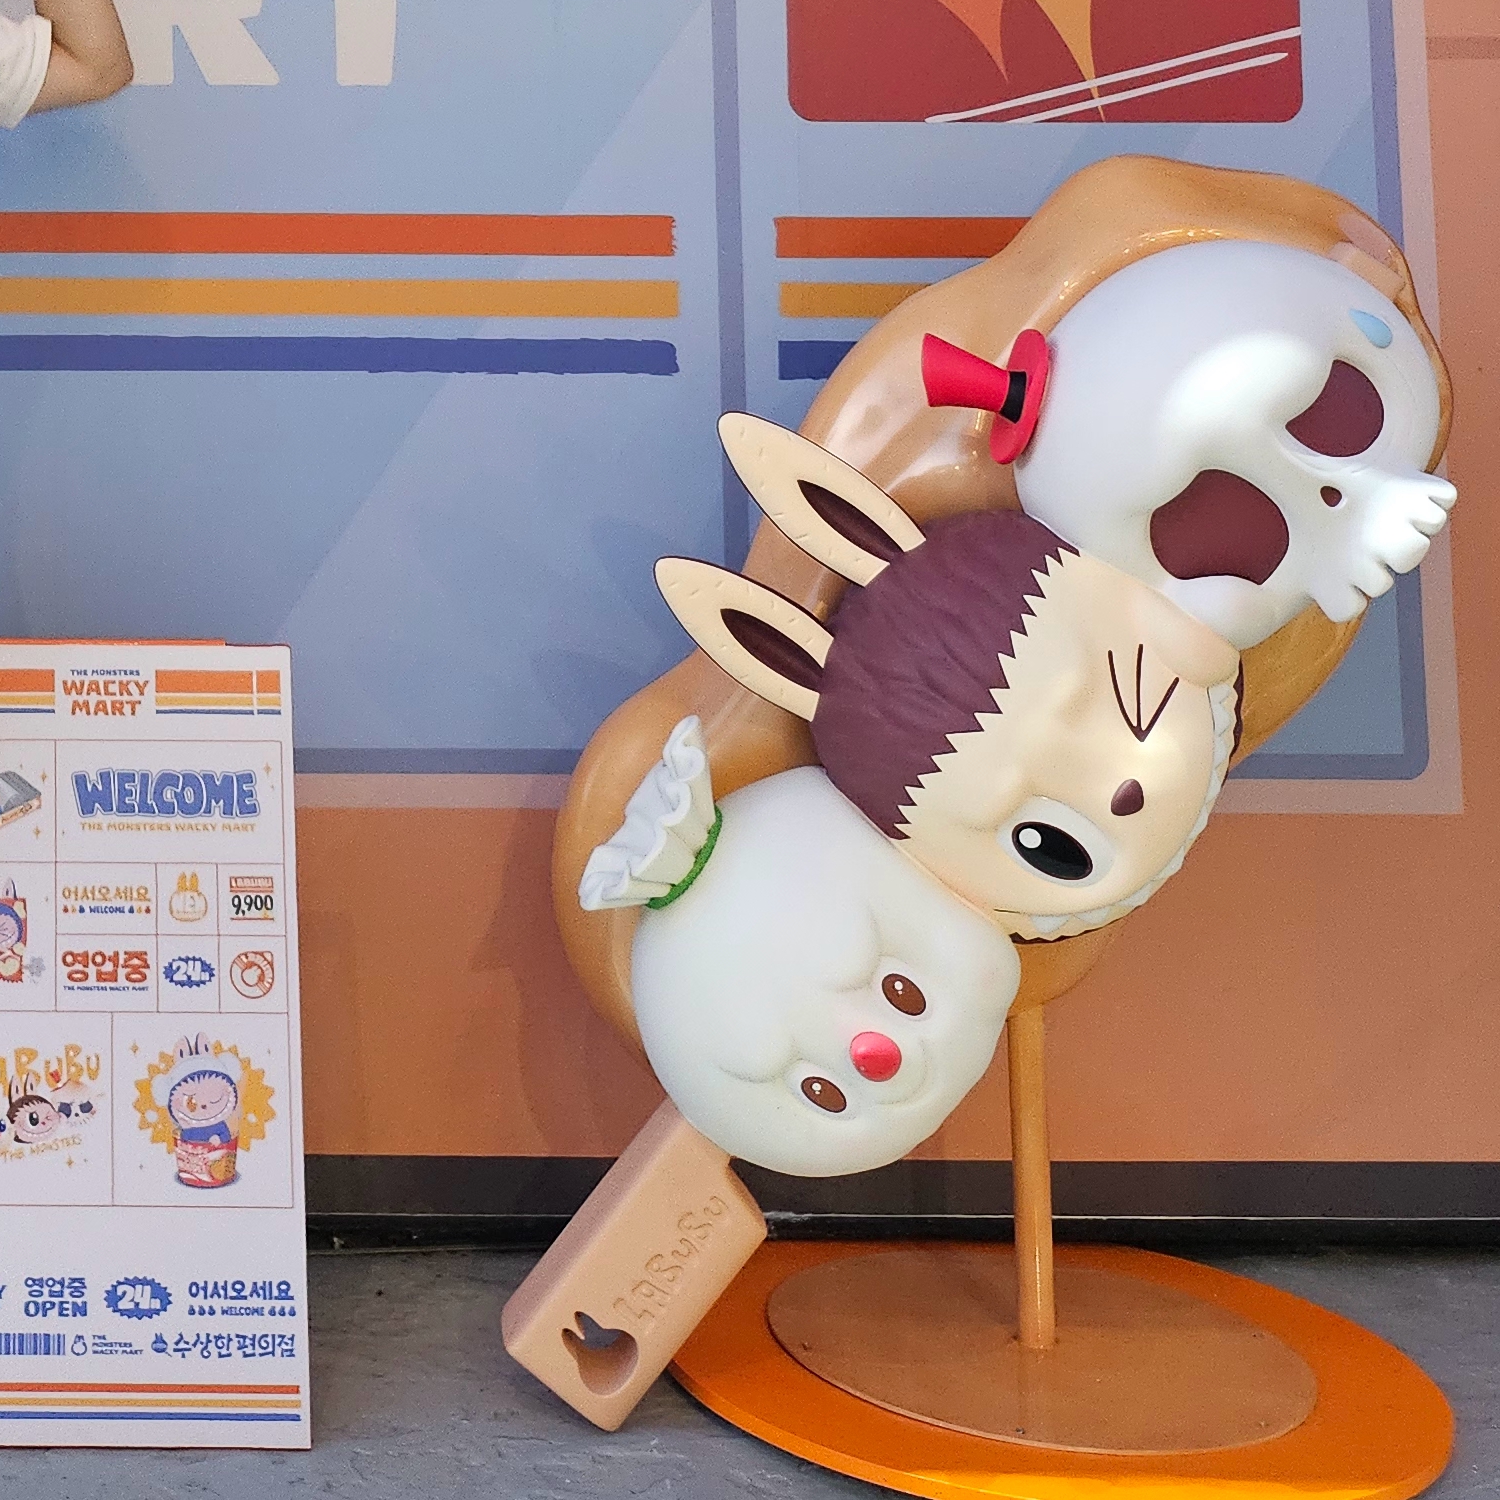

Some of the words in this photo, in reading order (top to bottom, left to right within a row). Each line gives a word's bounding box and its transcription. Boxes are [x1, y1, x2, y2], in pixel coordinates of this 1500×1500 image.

[62, 679, 150, 696] WACKY
[71, 699, 142, 716] MART
[72, 769, 259, 817] WELCOME
[81, 822, 103, 831] THE
[106, 822, 171, 832] MONSTERS
[175, 822, 217, 832] WACKY
[222, 822, 257, 833] MART
[62, 885, 151, 902] 어서오세요
[88, 905, 126, 914] WELCOME
[231, 894, 274, 917] 9,900
[61, 949, 151, 983] 영업중
[23, 1276, 88, 1299] 영업중
[188, 1279, 295, 1301] 어서오세요
[23, 1300, 88, 1318] OPEN
[220, 1305, 265, 1316] WELCOME
[172, 1331, 233, 1360] 수상한
[234, 1332, 296, 1359] 편의점
